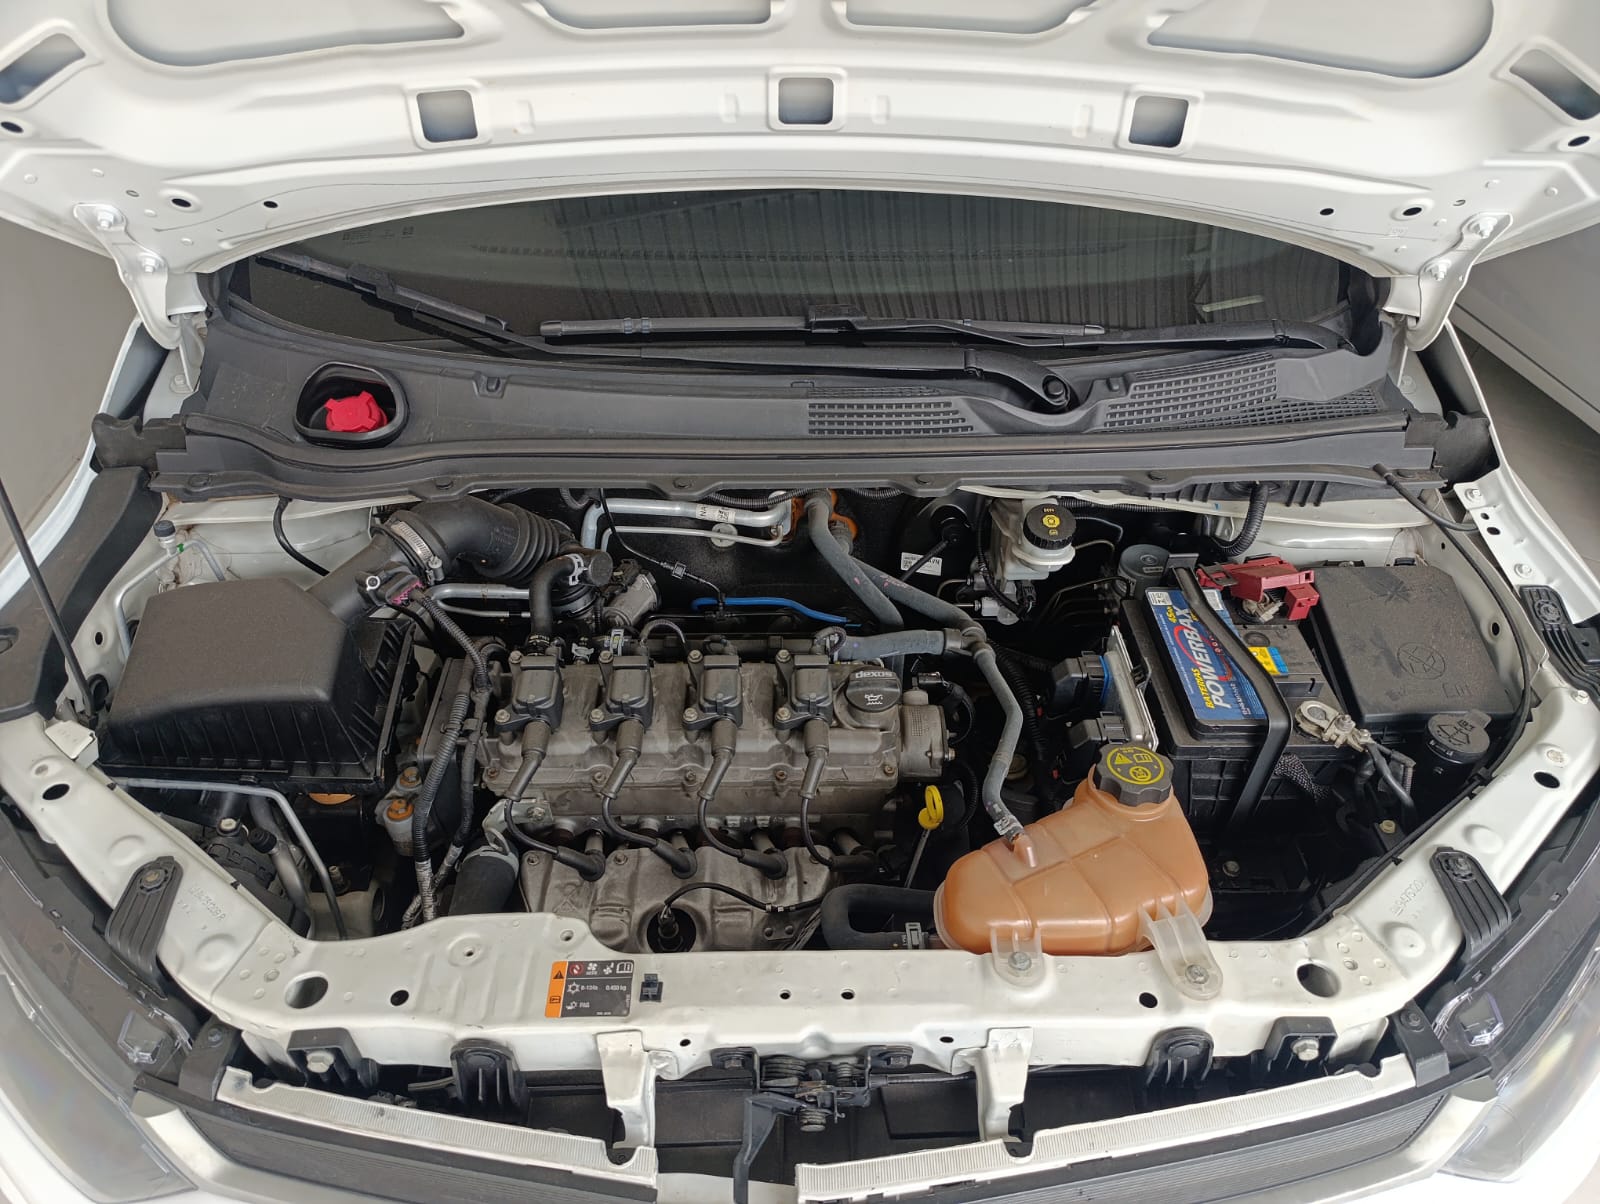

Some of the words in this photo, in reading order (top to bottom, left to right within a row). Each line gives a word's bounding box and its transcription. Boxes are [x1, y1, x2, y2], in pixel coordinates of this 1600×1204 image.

[855, 670, 893, 679] dexos
[1171, 605, 1233, 709] POWERBAX
[1191, 667, 1215, 709] BATERIAS
